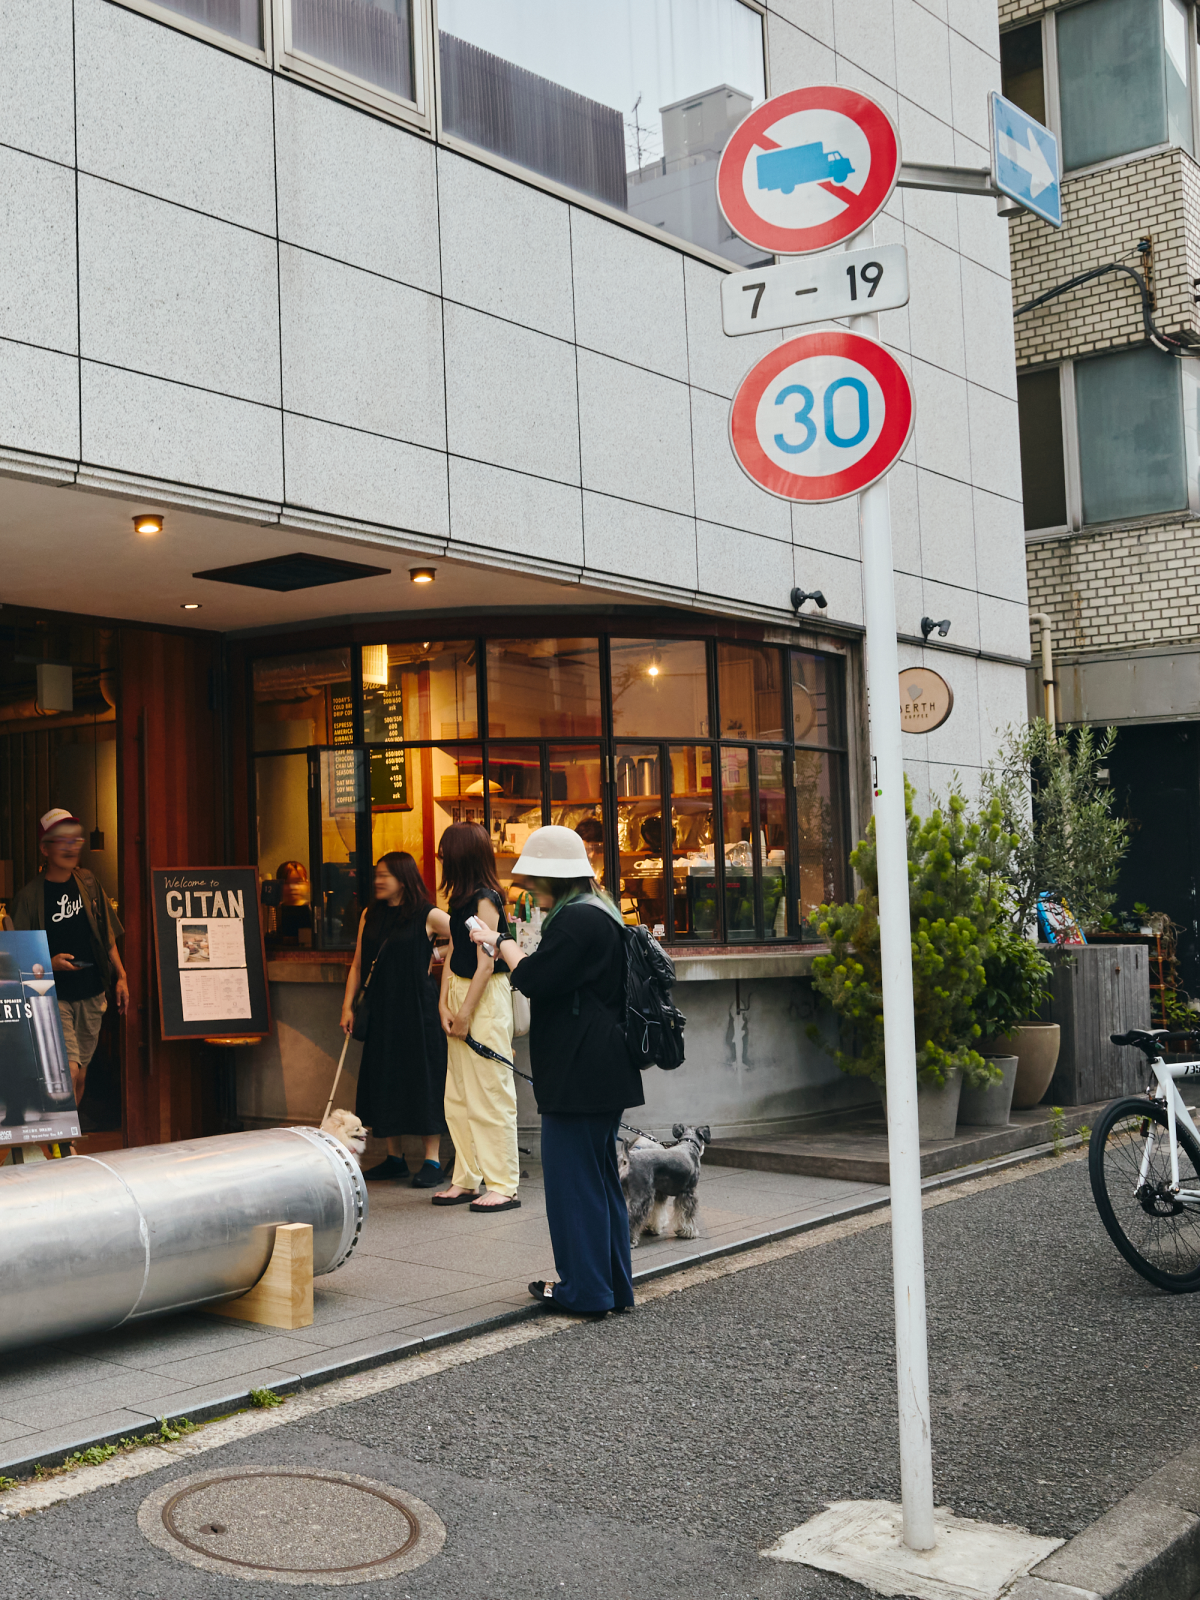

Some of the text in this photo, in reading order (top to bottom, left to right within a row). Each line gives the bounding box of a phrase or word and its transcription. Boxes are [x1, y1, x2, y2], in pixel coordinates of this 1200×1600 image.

[742, 282, 766, 319] 7
[846, 261, 884, 301] 19
[774, 376, 870, 454] 30
[333, 696, 350, 704] TODAY'S
[900, 702, 936, 714] ERTH
[391, 763, 399, 771] ask
[164, 876, 220, 889] Welcome to
[166, 889, 245, 919] CITAN
